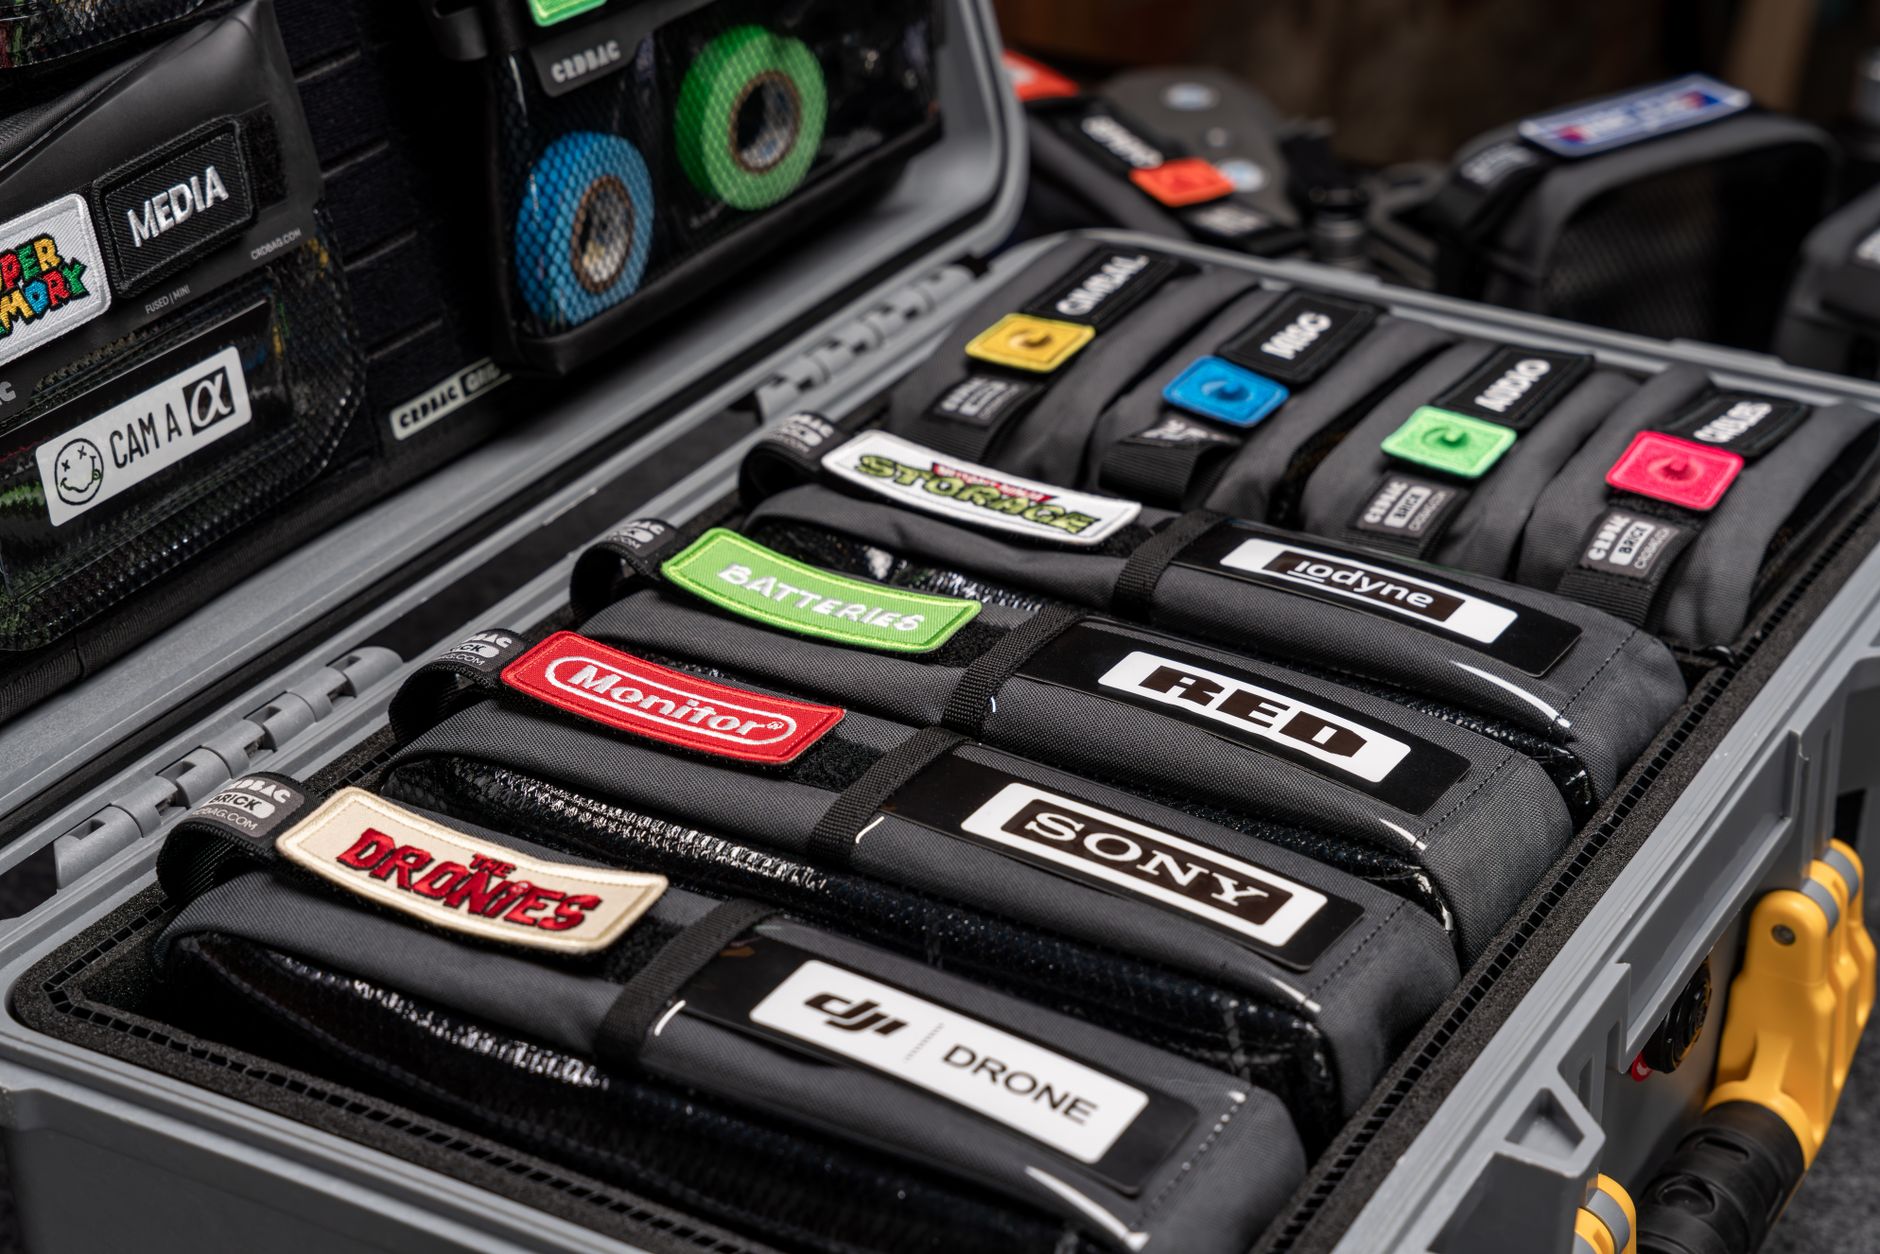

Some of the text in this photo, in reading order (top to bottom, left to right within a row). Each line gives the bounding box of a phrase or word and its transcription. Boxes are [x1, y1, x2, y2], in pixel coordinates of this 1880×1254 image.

[127, 165, 229, 247] MEDIA
[145, 296, 170, 314] FUSED
[174, 285, 191, 300] MINI
[1261, 312, 1332, 360] MISC
[1474, 359, 1551, 412] AUDIO
[109, 412, 160, 469] CAM
[165, 403, 182, 443] A
[853, 454, 1101, 534] STORAGE
[1618, 526, 1647, 555] BRICK
[717, 562, 925, 631] BATTERIES
[1138, 665, 1368, 758] RED
[336, 827, 603, 931] DRONIES
[469, 853, 518, 878] THE
[1024, 812, 1269, 907] SONY
[803, 991, 1099, 1127] dji DRONE
